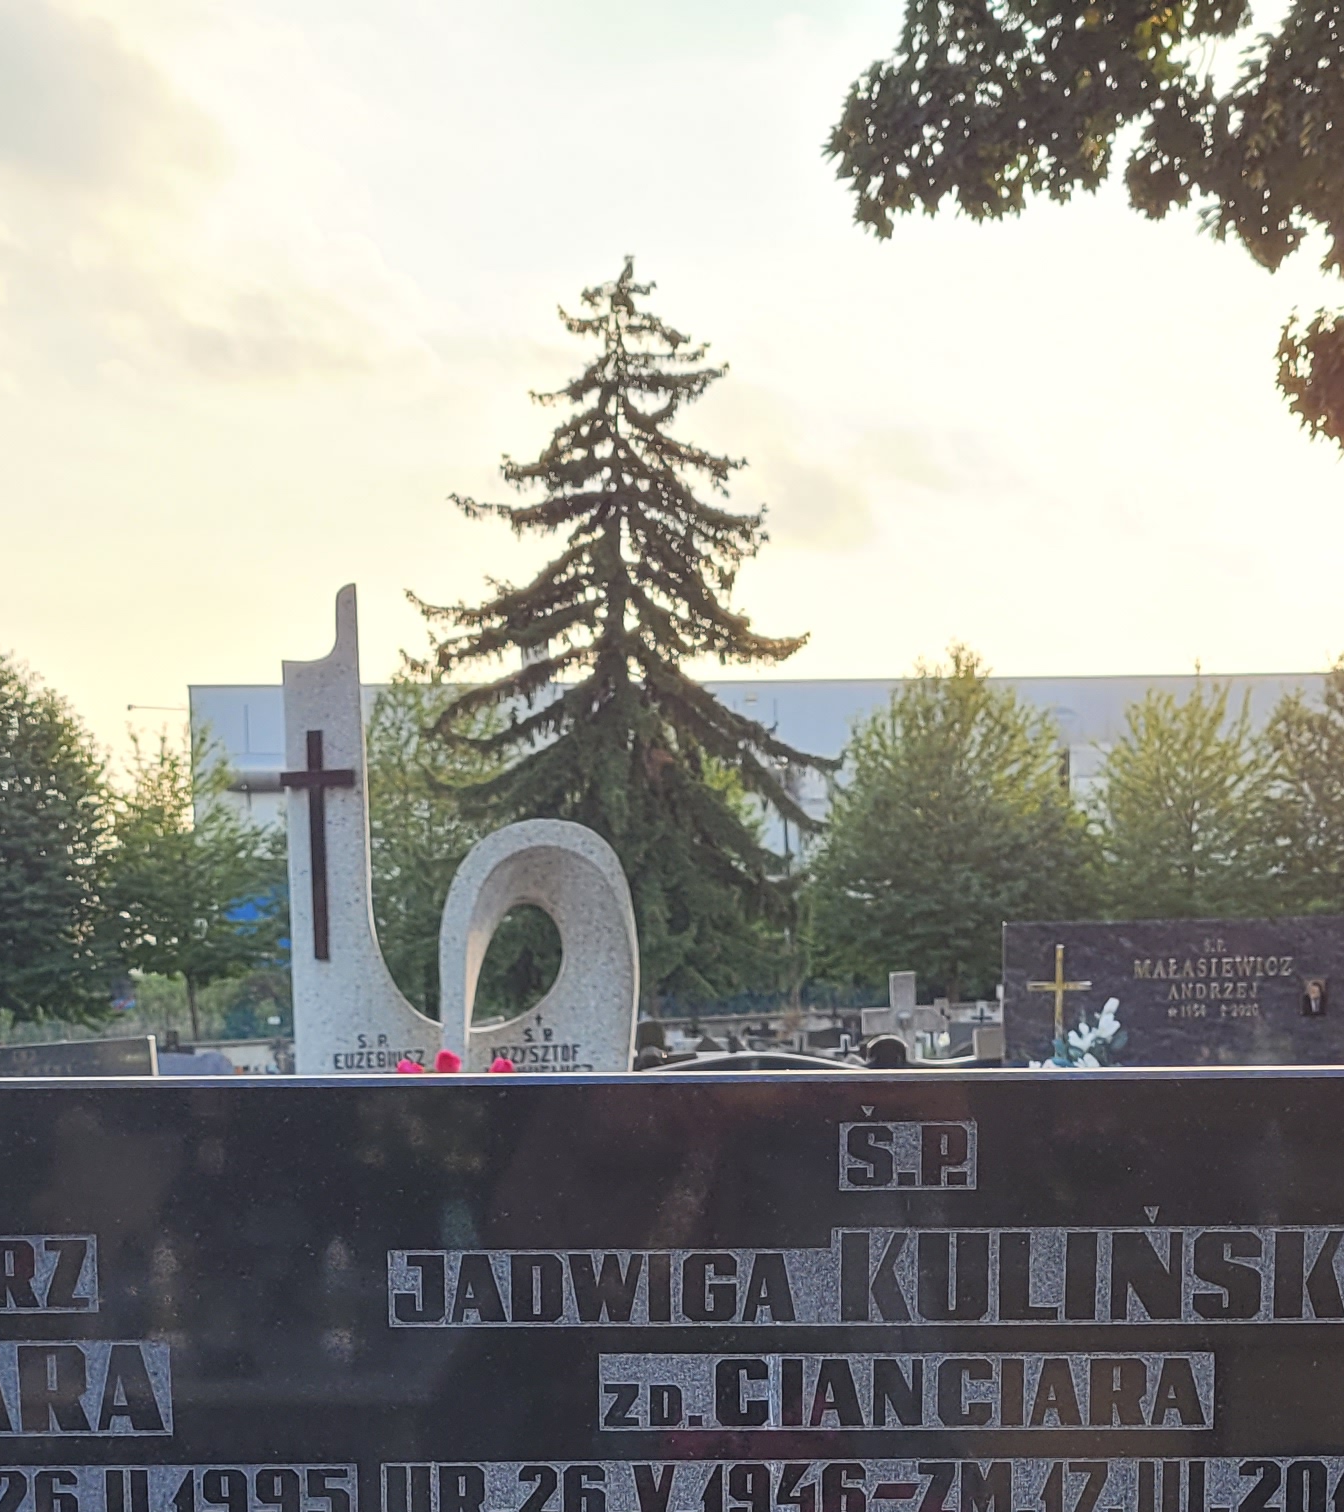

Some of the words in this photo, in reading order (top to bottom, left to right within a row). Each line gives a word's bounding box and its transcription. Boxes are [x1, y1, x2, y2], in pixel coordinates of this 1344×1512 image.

[1133, 955, 1294, 979] MAŁASIEWICZ
[1168, 982, 1259, 1001] ANDRZEJ
[394, 1252, 796, 1324] JADWIGA
